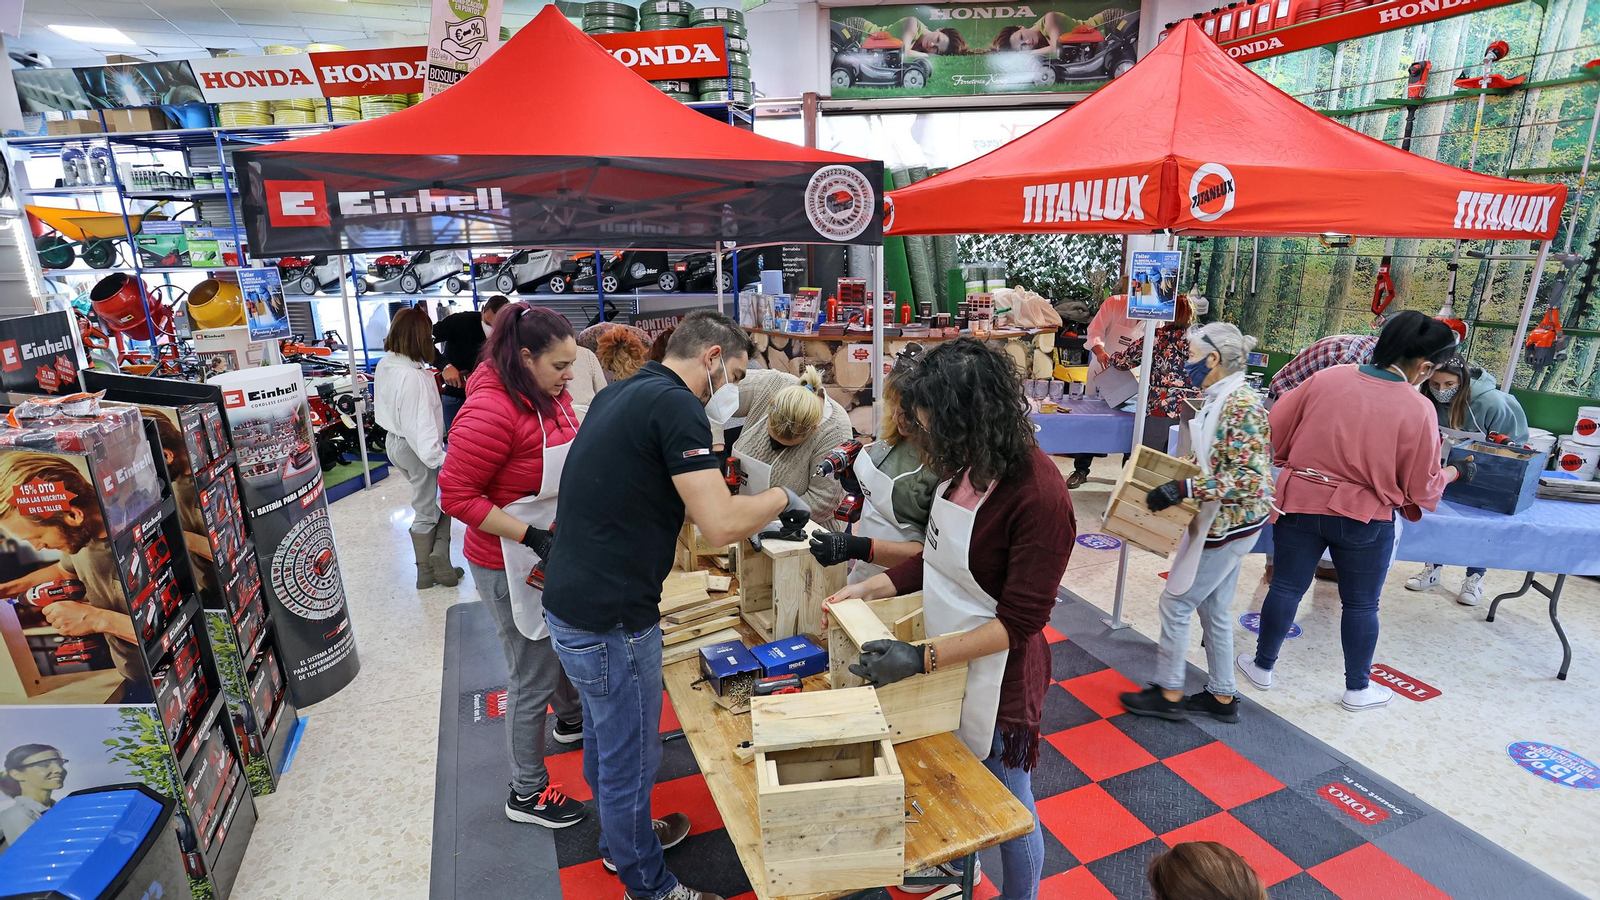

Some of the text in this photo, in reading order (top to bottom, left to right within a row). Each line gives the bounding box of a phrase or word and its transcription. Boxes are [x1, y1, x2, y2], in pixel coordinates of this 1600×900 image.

[929, 5, 1037, 21] HONDA
[606, 43, 721, 68] ONDA
[1225, 37, 1284, 58] ONDA
[204, 68, 314, 90] HONDA
[337, 187, 503, 215] Einhell
[1022, 175, 1149, 223] TITANLUX
[1191, 178, 1235, 209] TITANLUX
[1454, 190, 1557, 233] TITANLUX
[530, 253, 549, 261] HONDA
[635, 316, 678, 331] CONTIGO
[20, 335, 72, 361] Einhell
[248, 382, 298, 401] Einhell
[251, 400, 277, 409] CORDLESS
[115, 453, 152, 485] Einhell
[16, 497, 30, 505] PARA
[41, 494, 67, 503] INSCRITAS
[20, 483, 55, 496] 15% DTO
[44, 504, 62, 513] TALLER
[256, 499, 283, 516] BATERÍA
[283, 492, 297, 505] PARA
[141, 511, 162, 533] Einhell
[293, 666, 309, 676] PARA
[308, 649, 342, 670] EXPERIMENTAR
[306, 650, 328, 664] SISTEMA
[788, 660, 806, 670] INDEX
[298, 673, 306, 681] DE
[306, 669, 317, 678] TUS
[473, 694, 481, 709] Count
[192, 758, 209, 790] Einhell
[1520, 751, 1585, 785] 15%
[1353, 783, 1369, 793] on
[1328, 785, 1378, 821] TORO
[1368, 791, 1404, 815] Count
